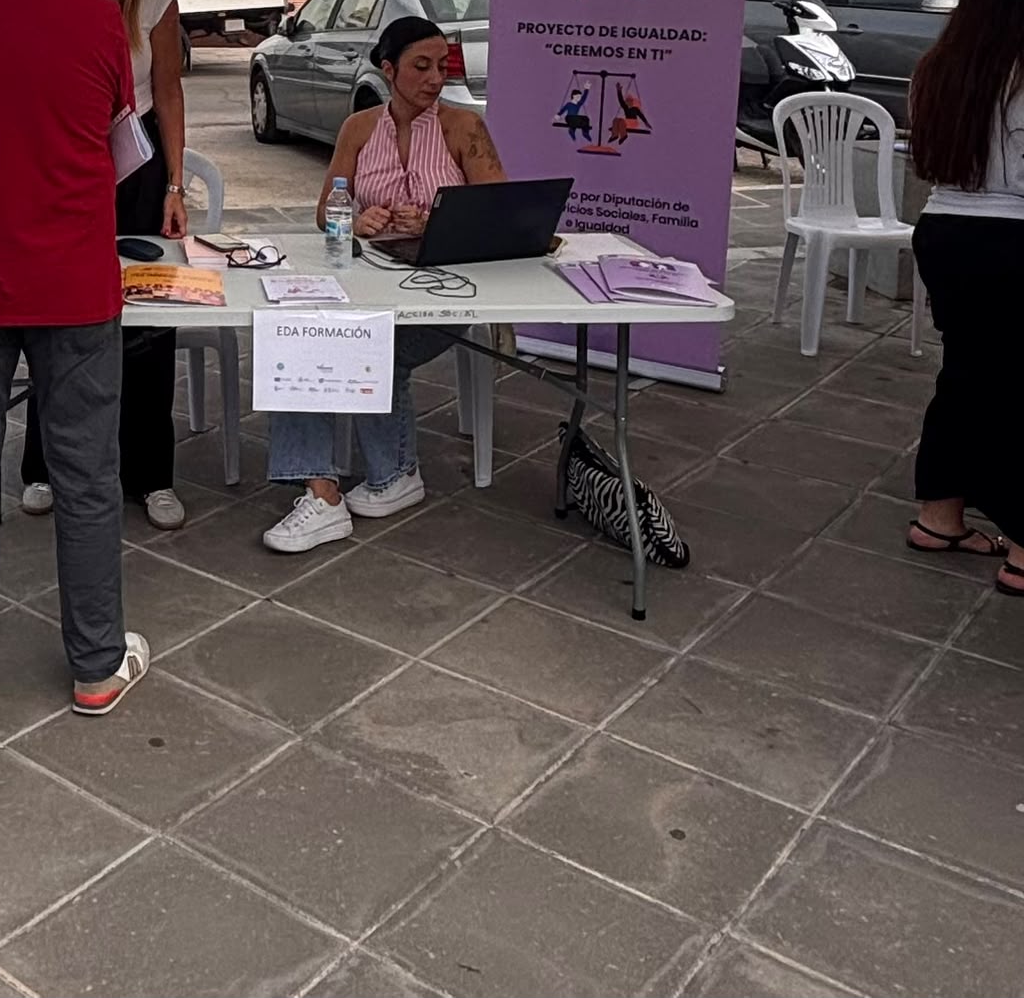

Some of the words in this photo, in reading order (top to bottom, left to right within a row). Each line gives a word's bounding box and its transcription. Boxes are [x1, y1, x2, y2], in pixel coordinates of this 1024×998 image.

[516, 22, 595, 37] PROYECTO
[598, 25, 618, 38] DE
[621, 26, 708, 43] IGUALDAD:
[544, 43, 625, 59] “CREEMOS
[627, 47, 647, 60] EN
[649, 48, 673, 62] TI”
[580, 192, 601, 203] por
[603, 193, 670, 211] Diputación
[672, 201, 690, 213] de
[565, 219, 574, 228] e
[575, 219, 630, 234] Igualdad
[596, 206, 649, 223] Sociales,
[651, 213, 699, 229] Familia
[276, 325, 299, 338] EDA
[302, 325, 372, 340] FORMACIÓN
